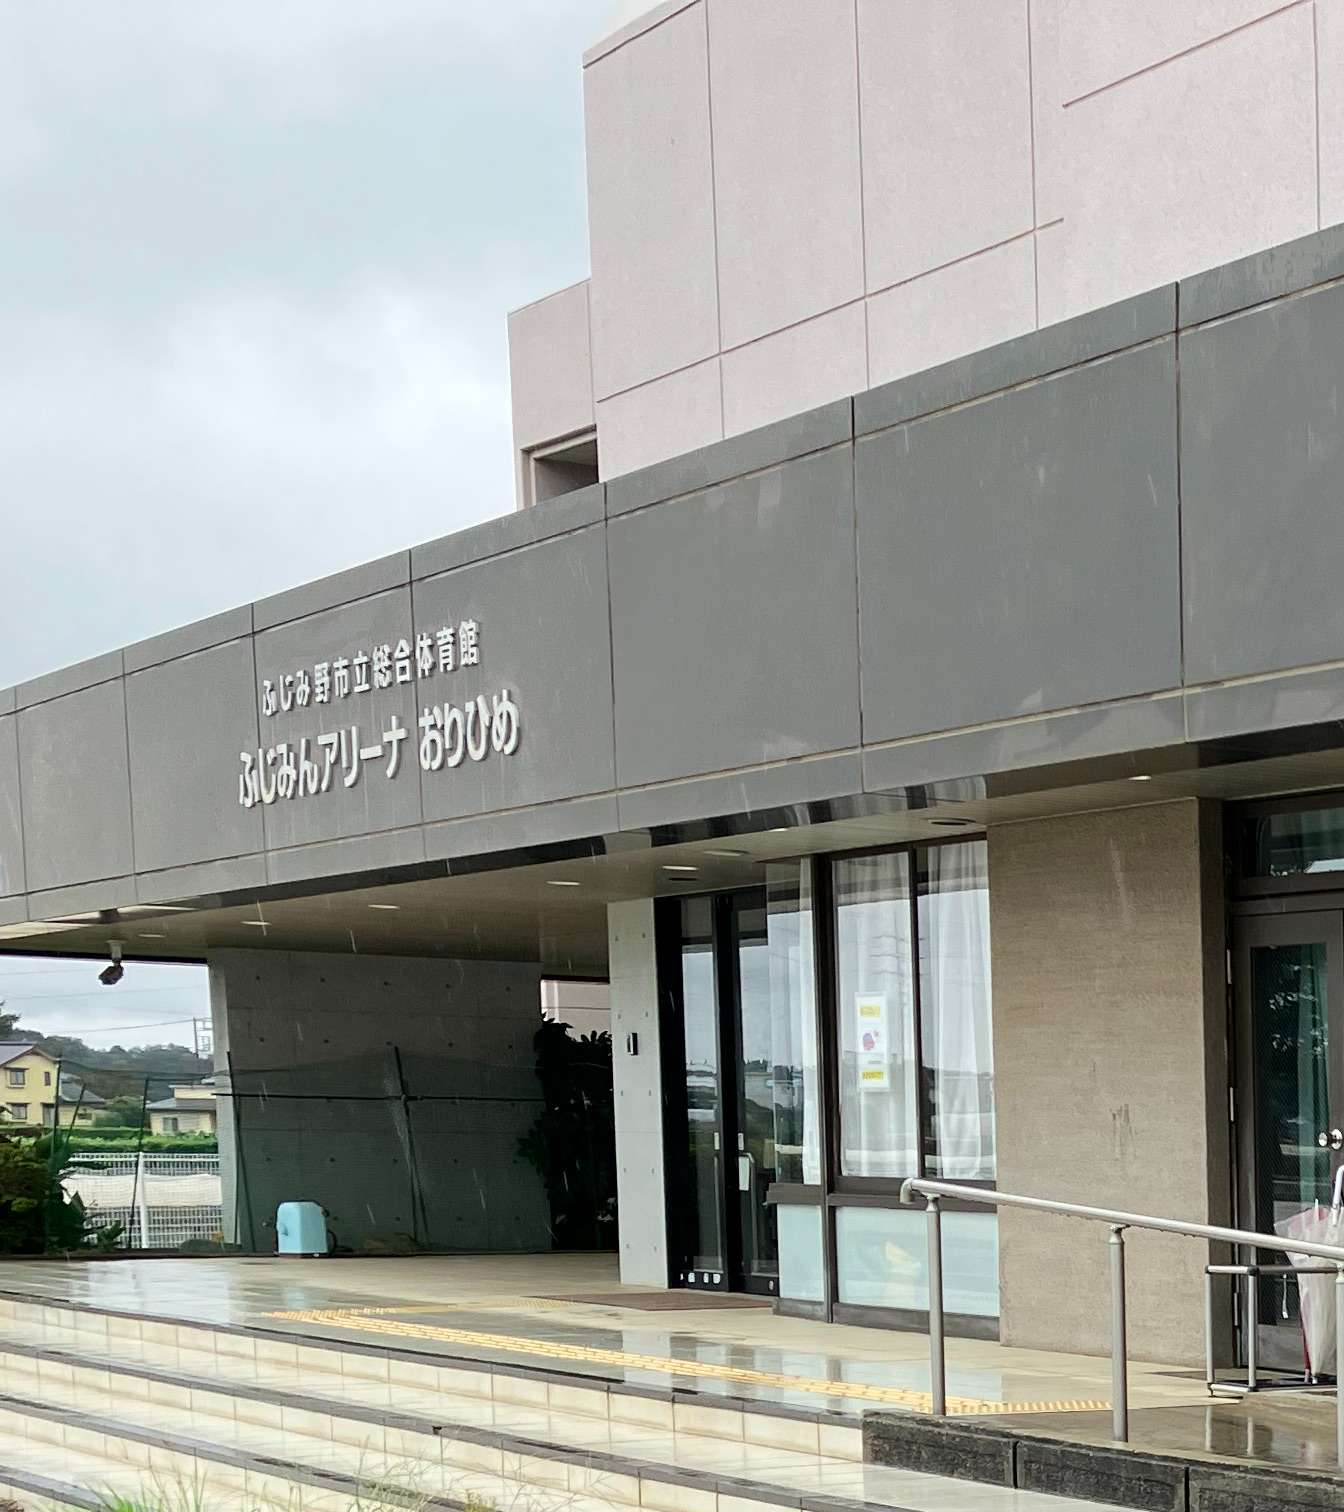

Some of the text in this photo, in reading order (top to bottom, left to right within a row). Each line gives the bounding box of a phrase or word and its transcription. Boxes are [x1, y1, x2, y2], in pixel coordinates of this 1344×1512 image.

[262, 619, 480, 717] ふじみ野市立総合体育館
[239, 689, 521, 808] ふじみんアリーナ おりひめ
